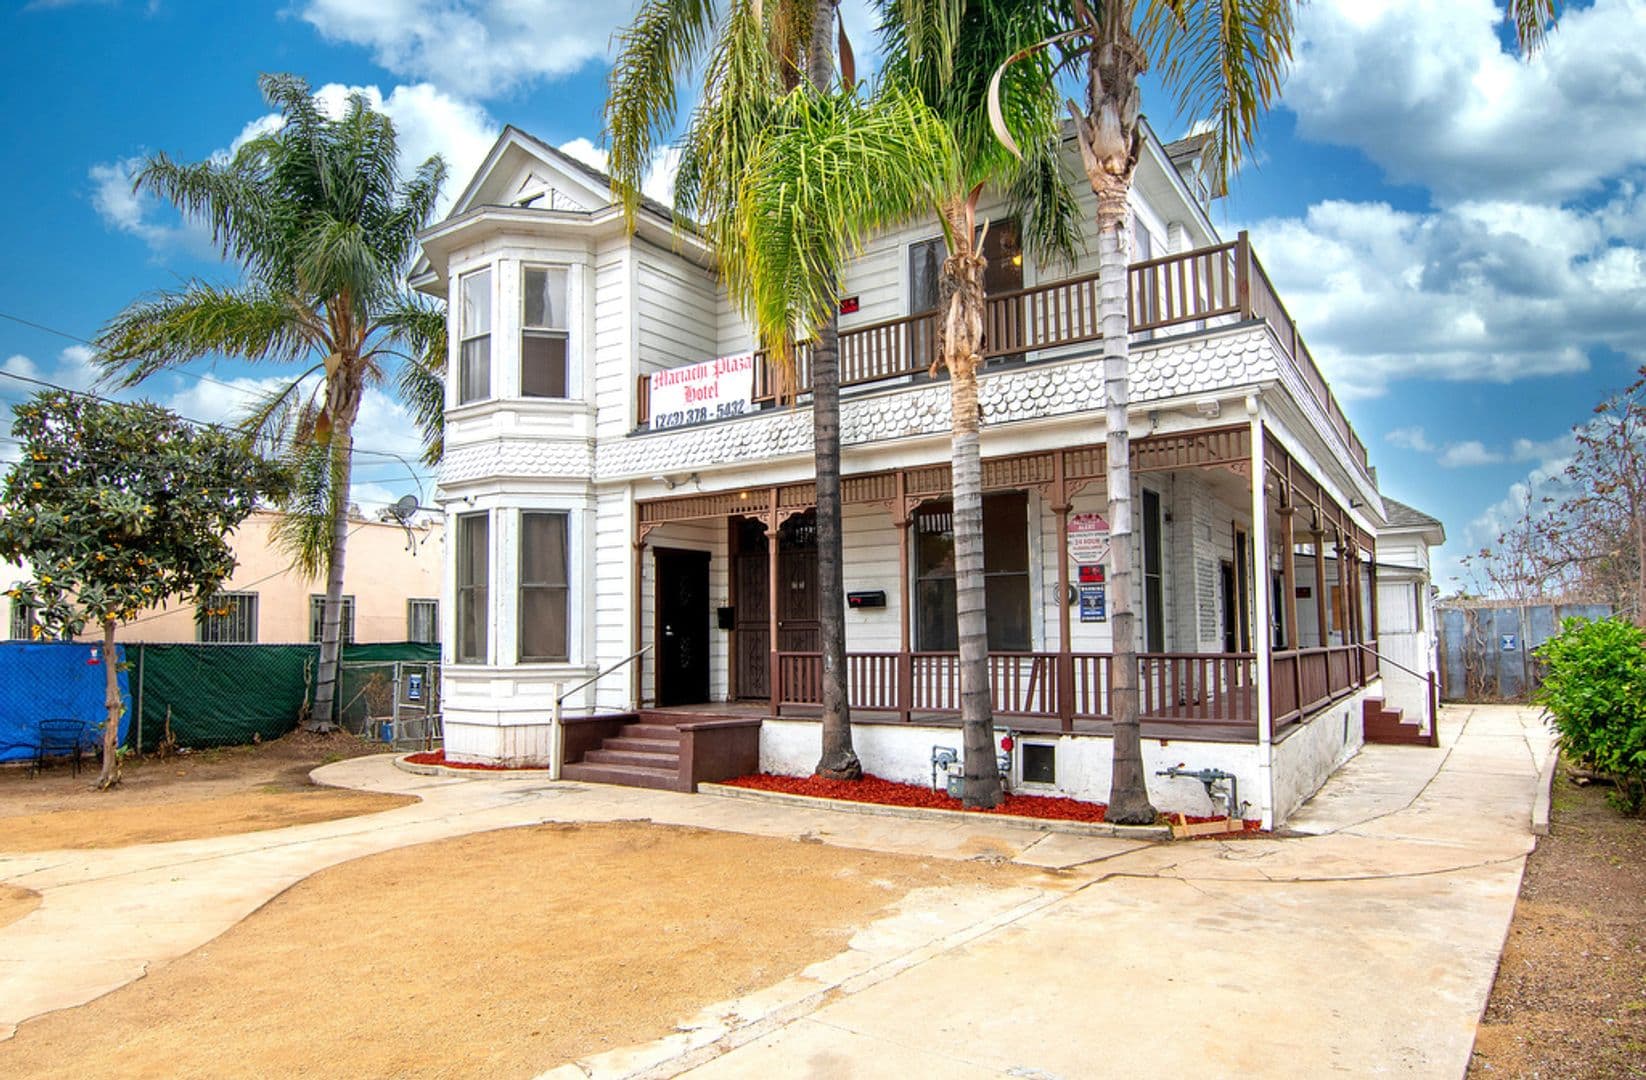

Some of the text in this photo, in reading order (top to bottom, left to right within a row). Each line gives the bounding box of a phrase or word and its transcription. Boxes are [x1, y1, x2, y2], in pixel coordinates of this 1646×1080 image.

[654, 356, 752, 390] Mariachi Plaza
[684, 381, 719, 404] Hotel
[686, 406, 707, 425] 378
[717, 399, 745, 418] 5432
